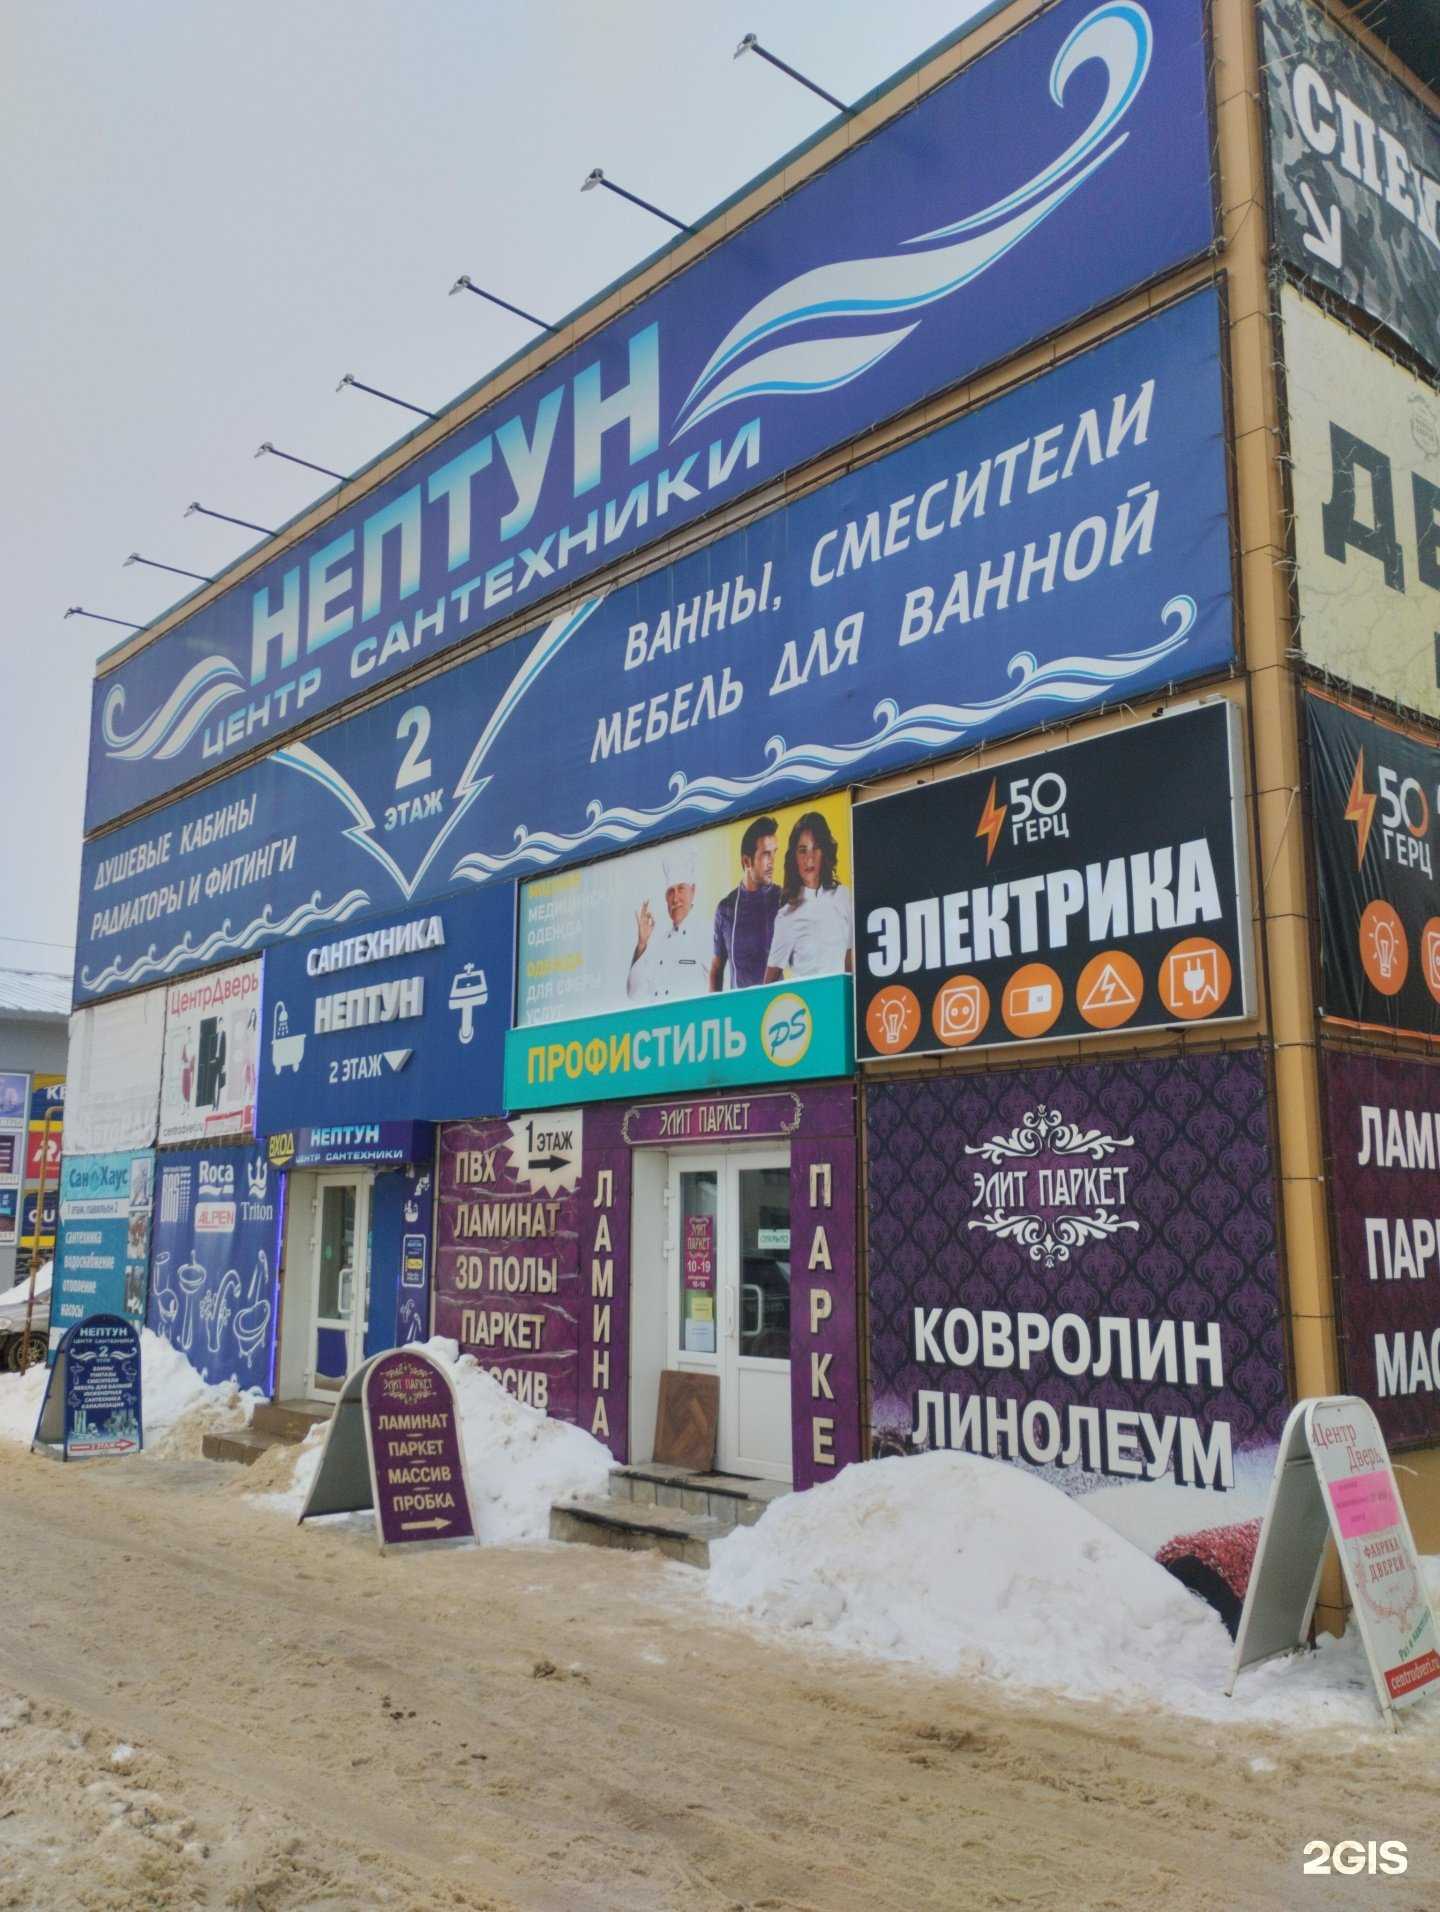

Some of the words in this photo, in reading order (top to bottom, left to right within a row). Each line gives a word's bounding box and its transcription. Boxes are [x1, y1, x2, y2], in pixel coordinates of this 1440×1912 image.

[251, 321, 660, 687] НЕПТУН
[624, 562, 782, 671] ВАННЫ,
[809, 378, 1155, 587] СМЕСИТЕЛИ
[203, 667, 321, 758] ЦЕНТР
[350, 417, 761, 679] САНТЕХНИКИ
[590, 667, 744, 763] МЕБЕЛЬ
[769, 611, 864, 696] ДЛЯ
[898, 482, 1160, 646] ВАННОЙ
[395, 706, 432, 790] 2
[384, 788, 443, 831] ЭТАЖ
[1010, 772, 1067, 822] 50
[1378, 766, 1429, 838] 50
[94, 832, 172, 891] ДУШЕВЫЕ
[179, 793, 256, 855] КАБИНЫ
[1013, 813, 1069, 845] ГЕРЦ
[1383, 828, 1433, 880] ГЕРЦ
[90, 877, 184, 941] РАДИАТОРЫ
[187, 872, 201, 904] И
[204, 836, 297, 899] ФИТИНГИ
[867, 838, 1222, 977] ЭЛЕКТРИКА
[307, 916, 445, 977] САНТЕХНИКА
[171, 972, 259, 1015] ЦентрДверь
[314, 976, 424, 1034] НЕПТУН
[328, 1061, 338, 1083] 2
[342, 1054, 382, 1079] ЭТАЖ
[527, 1017, 747, 1084] ПРОФИСТИЛЬ
[310, 1124, 380, 1147] НЕПТУН
[525, 1121, 533, 1153] 1
[536, 1129, 573, 1151] ЭТАЖ
[660, 1108, 693, 1136] ЭЛИТ
[699, 1103, 750, 1133] ПАРКЕТ
[269, 1132, 295, 1157] ВХОД
[326, 1149, 403, 1161] САНТЕХНИКИ
[100, 1165, 128, 1191] Хаус
[199, 1160, 234, 1185] Roca
[455, 1151, 497, 1184] ПВХ
[973, 1170, 1028, 1207] ЭЛИТ
[1039, 1166, 1128, 1206] ПАРКЕТ
[241, 1201, 273, 1221] Triton
[454, 1203, 561, 1238] ЛАМИНАТ
[1365, 1217, 1440, 1280] ПАР
[456, 1256, 483, 1290] 3D
[489, 1256, 558, 1292] ПОЛЫ
[80, 1327, 128, 1337] НЕПТУН
[461, 1310, 545, 1350] ПАРКЕТ
[914, 1307, 1224, 1387] КОВРОЛИН
[99, 1346, 109, 1358] 2
[378, 1413, 449, 1430] ЛАМИНАТ
[912, 1389, 1235, 1489] ЛИНОЛЕУМ
[388, 1440, 445, 1456] ПАРКЕТ
[388, 1467, 452, 1484] МАССИВ
[393, 1493, 455, 1512] ПРОБКА
